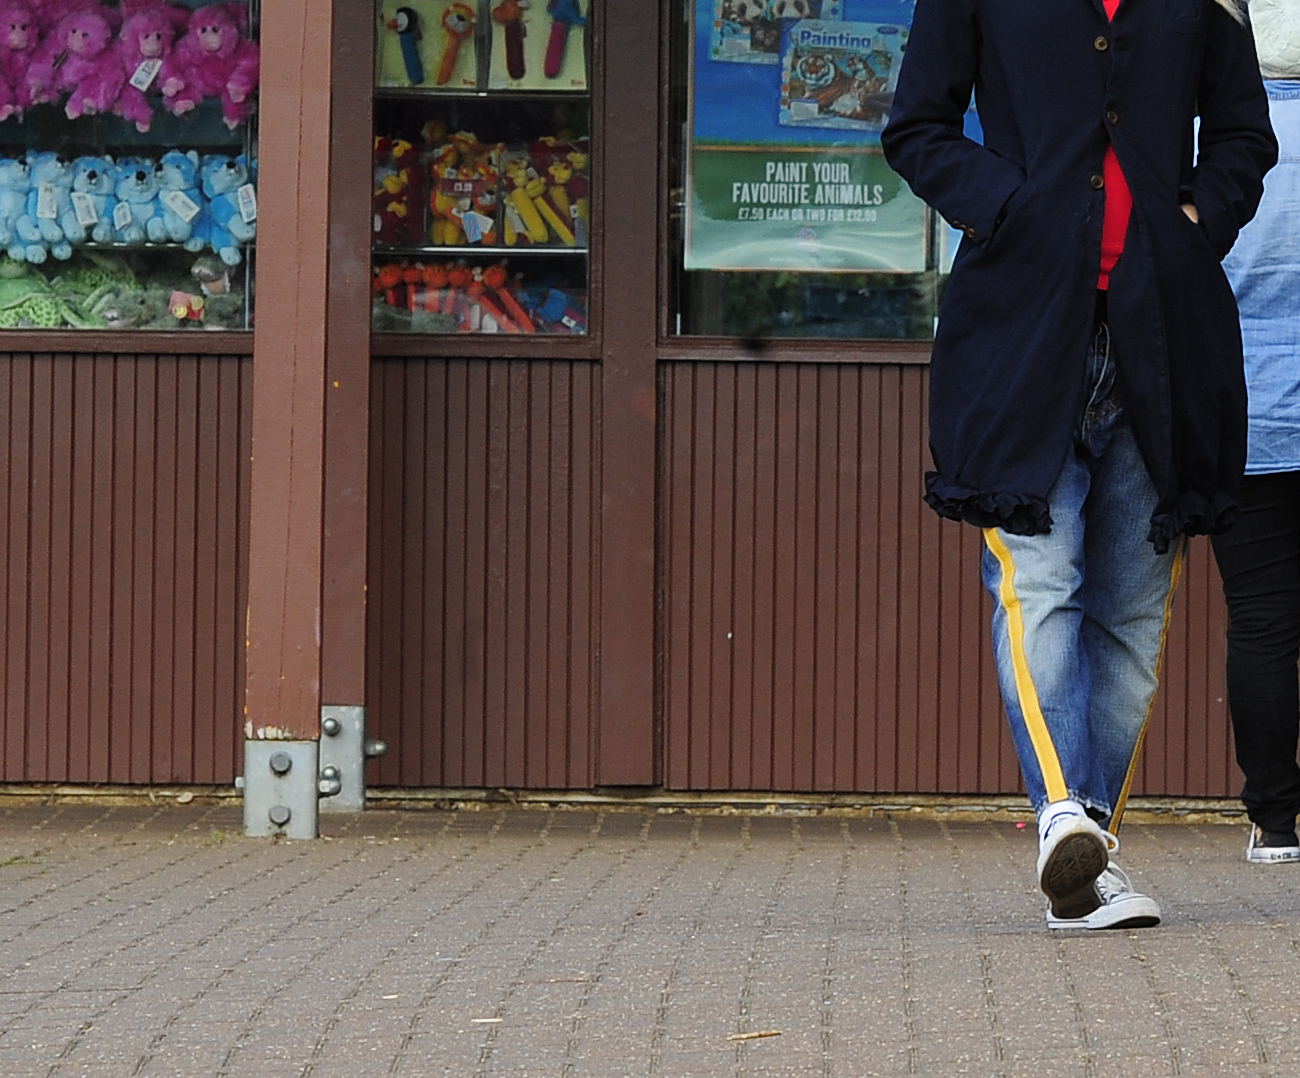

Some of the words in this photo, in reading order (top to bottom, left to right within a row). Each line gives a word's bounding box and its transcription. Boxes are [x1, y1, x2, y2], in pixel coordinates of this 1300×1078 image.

[800, 29, 872, 49] Painting
[812, 163, 850, 184] YOUR
[766, 208, 790, 221] EACH
[806, 209, 826, 221] TWO
[827, 209, 844, 221] FOR
